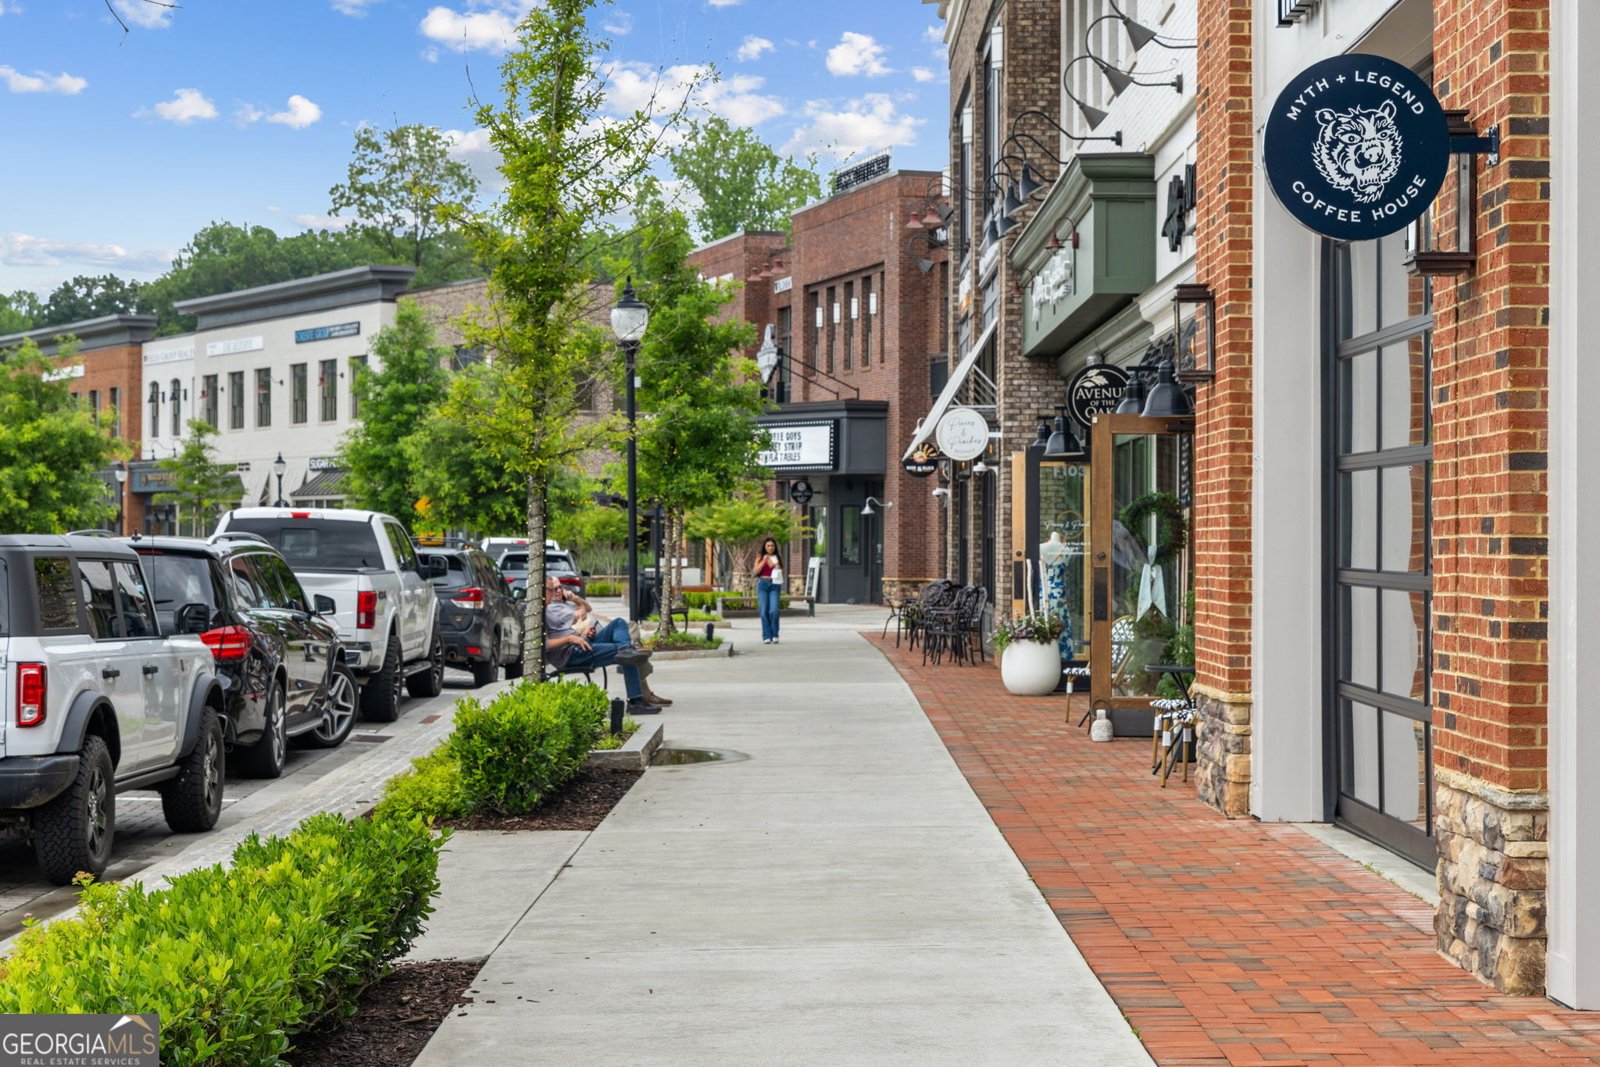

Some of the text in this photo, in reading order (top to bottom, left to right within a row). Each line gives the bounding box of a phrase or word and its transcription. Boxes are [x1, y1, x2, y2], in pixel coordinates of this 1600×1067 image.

[1286, 70, 1425, 121] MYTH + LEGEND
[1292, 174, 1427, 223] COFFEE HOUSE
[1076, 387, 1126, 400] AVENU
